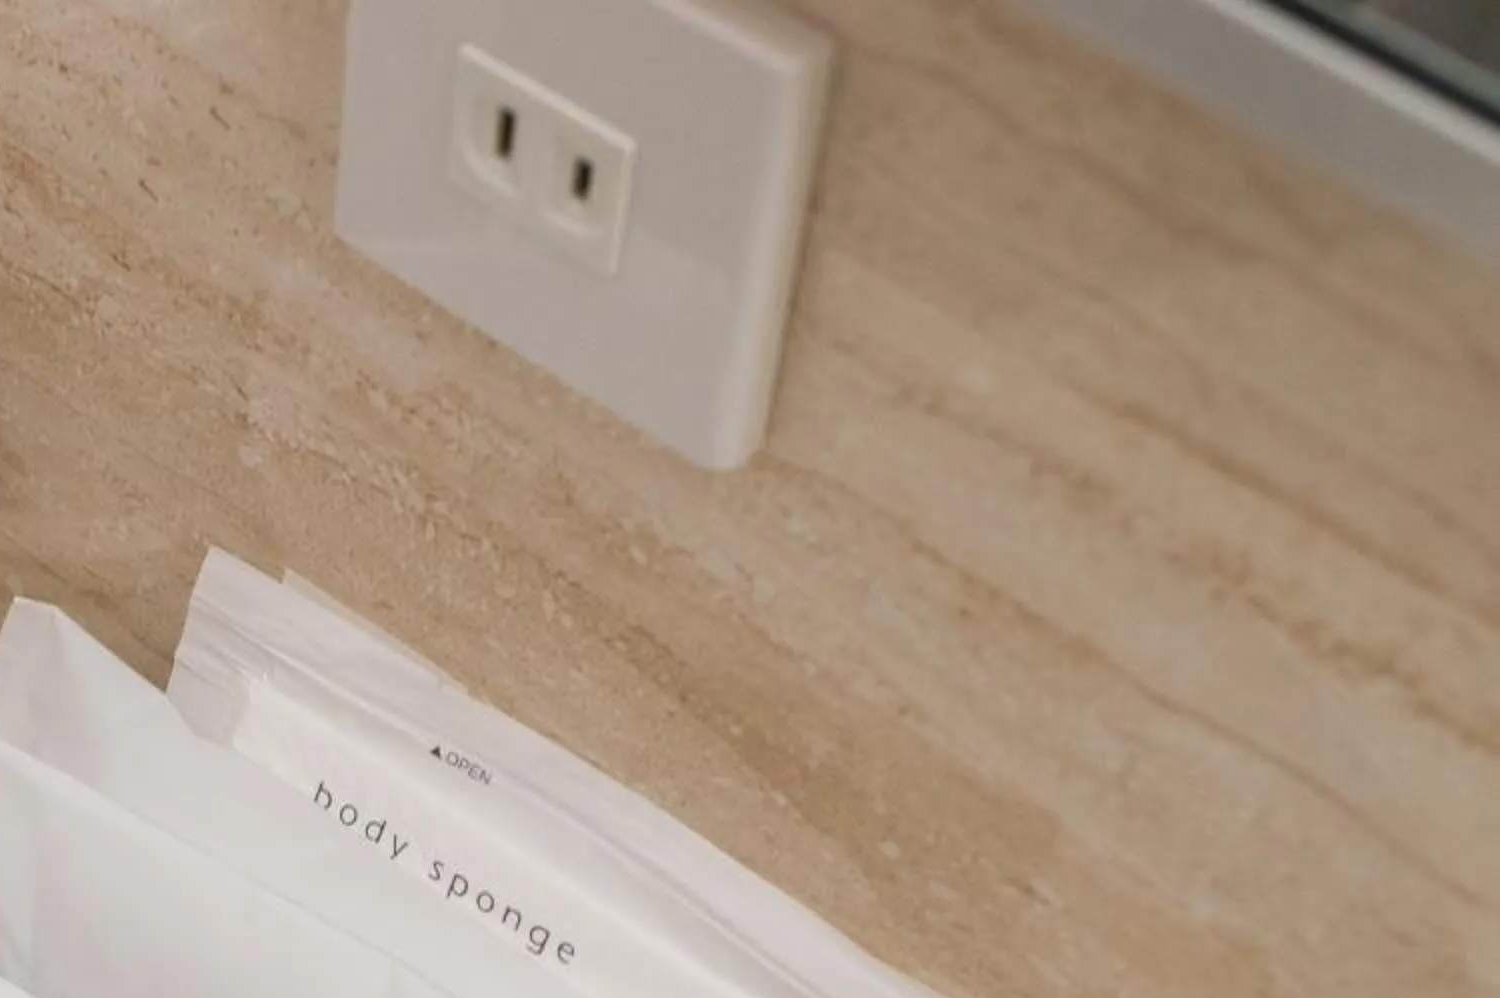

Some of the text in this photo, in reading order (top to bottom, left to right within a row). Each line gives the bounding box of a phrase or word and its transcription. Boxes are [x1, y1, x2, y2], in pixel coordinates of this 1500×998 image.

[445, 751, 492, 785] OPEN
[313, 781, 576, 964] body sponge
